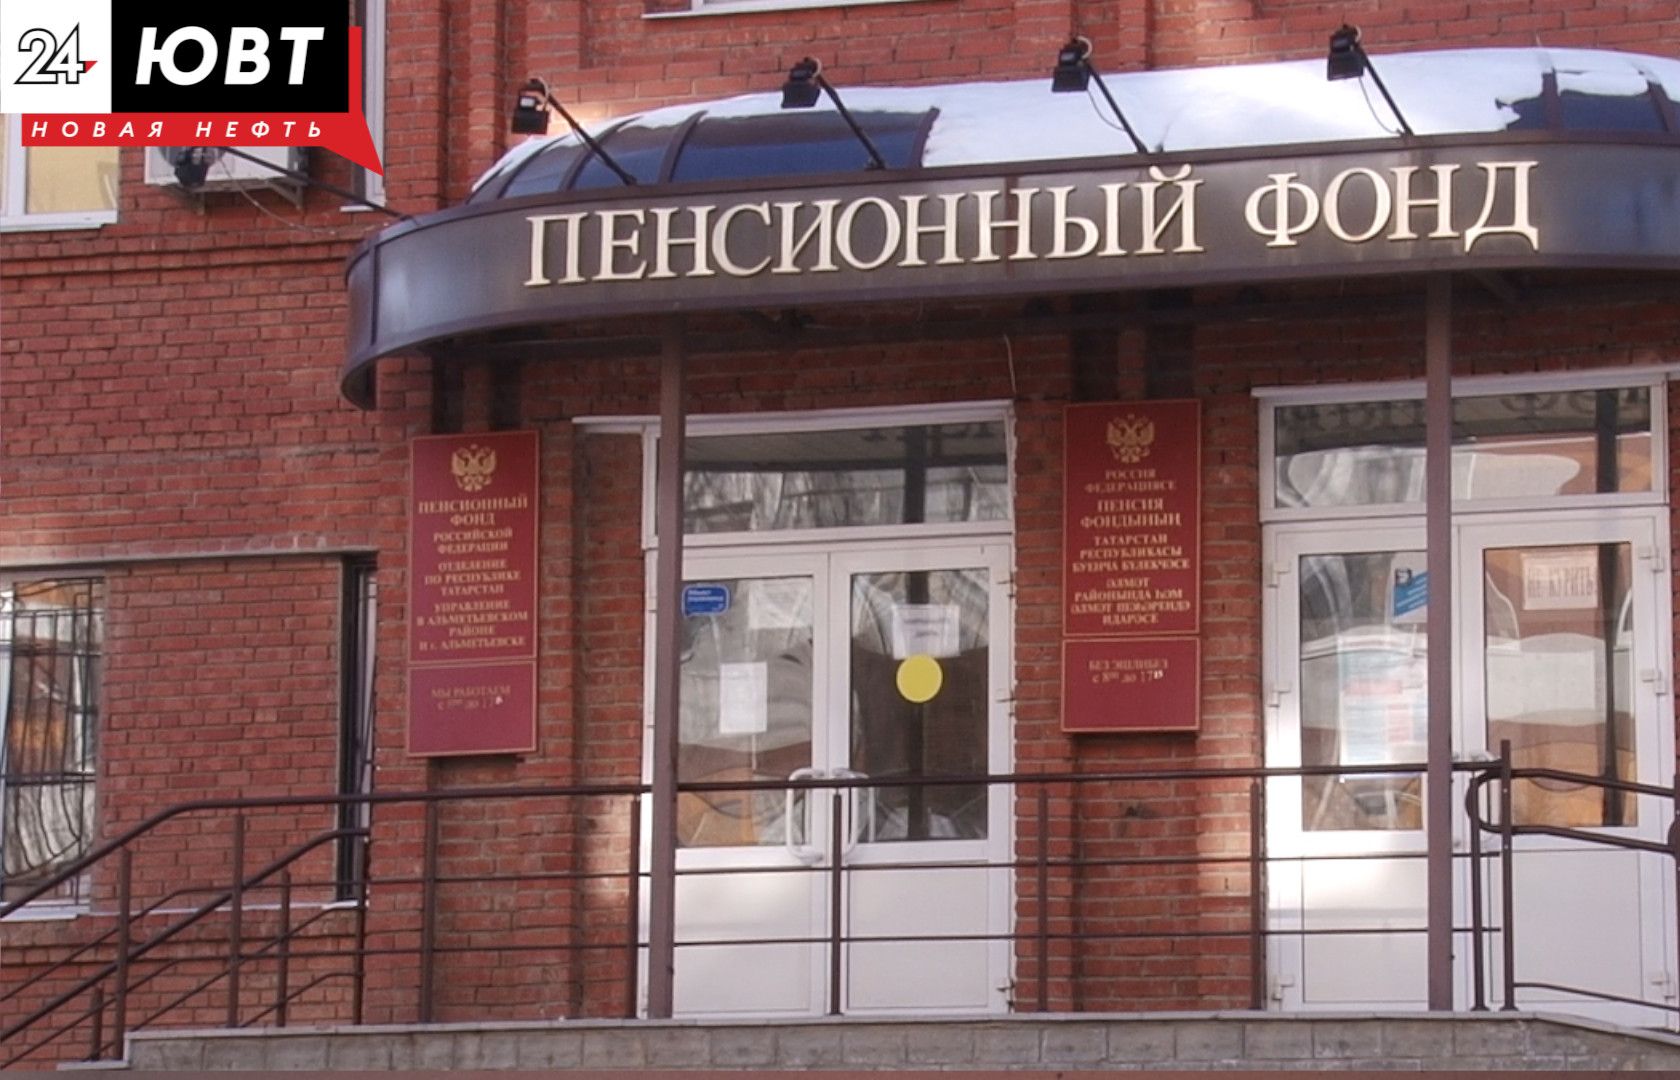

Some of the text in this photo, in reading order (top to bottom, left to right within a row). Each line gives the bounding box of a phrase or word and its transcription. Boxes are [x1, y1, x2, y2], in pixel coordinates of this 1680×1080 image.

[523, 160, 1540, 288] ПЕНСИОННЫЙ ФОНД
[1105, 469, 1156, 480] РОССИЯ
[418, 494, 528, 514] ПЕНСИОННЫЙ
[1098, 498, 1163, 512] ПЕНСИЯ
[450, 513, 496, 526] ФОНД
[434, 528, 513, 542] РОССИЙСКОЙ
[1095, 534, 1167, 546] ТАТАРСТАН
[437, 541, 508, 554] ФЕДЕРАЦИИ
[1080, 546, 1182, 560] РЕСПУБЛИКАСЫ
[438, 559, 507, 572] ОТДЕЛЕНИЕ
[425, 571, 521, 585] ПО РЕСПУБЛИКЕ
[441, 584, 504, 597] ТАТАРСТАН
[434, 600, 510, 613] УПРАВЛЕНИЕ
